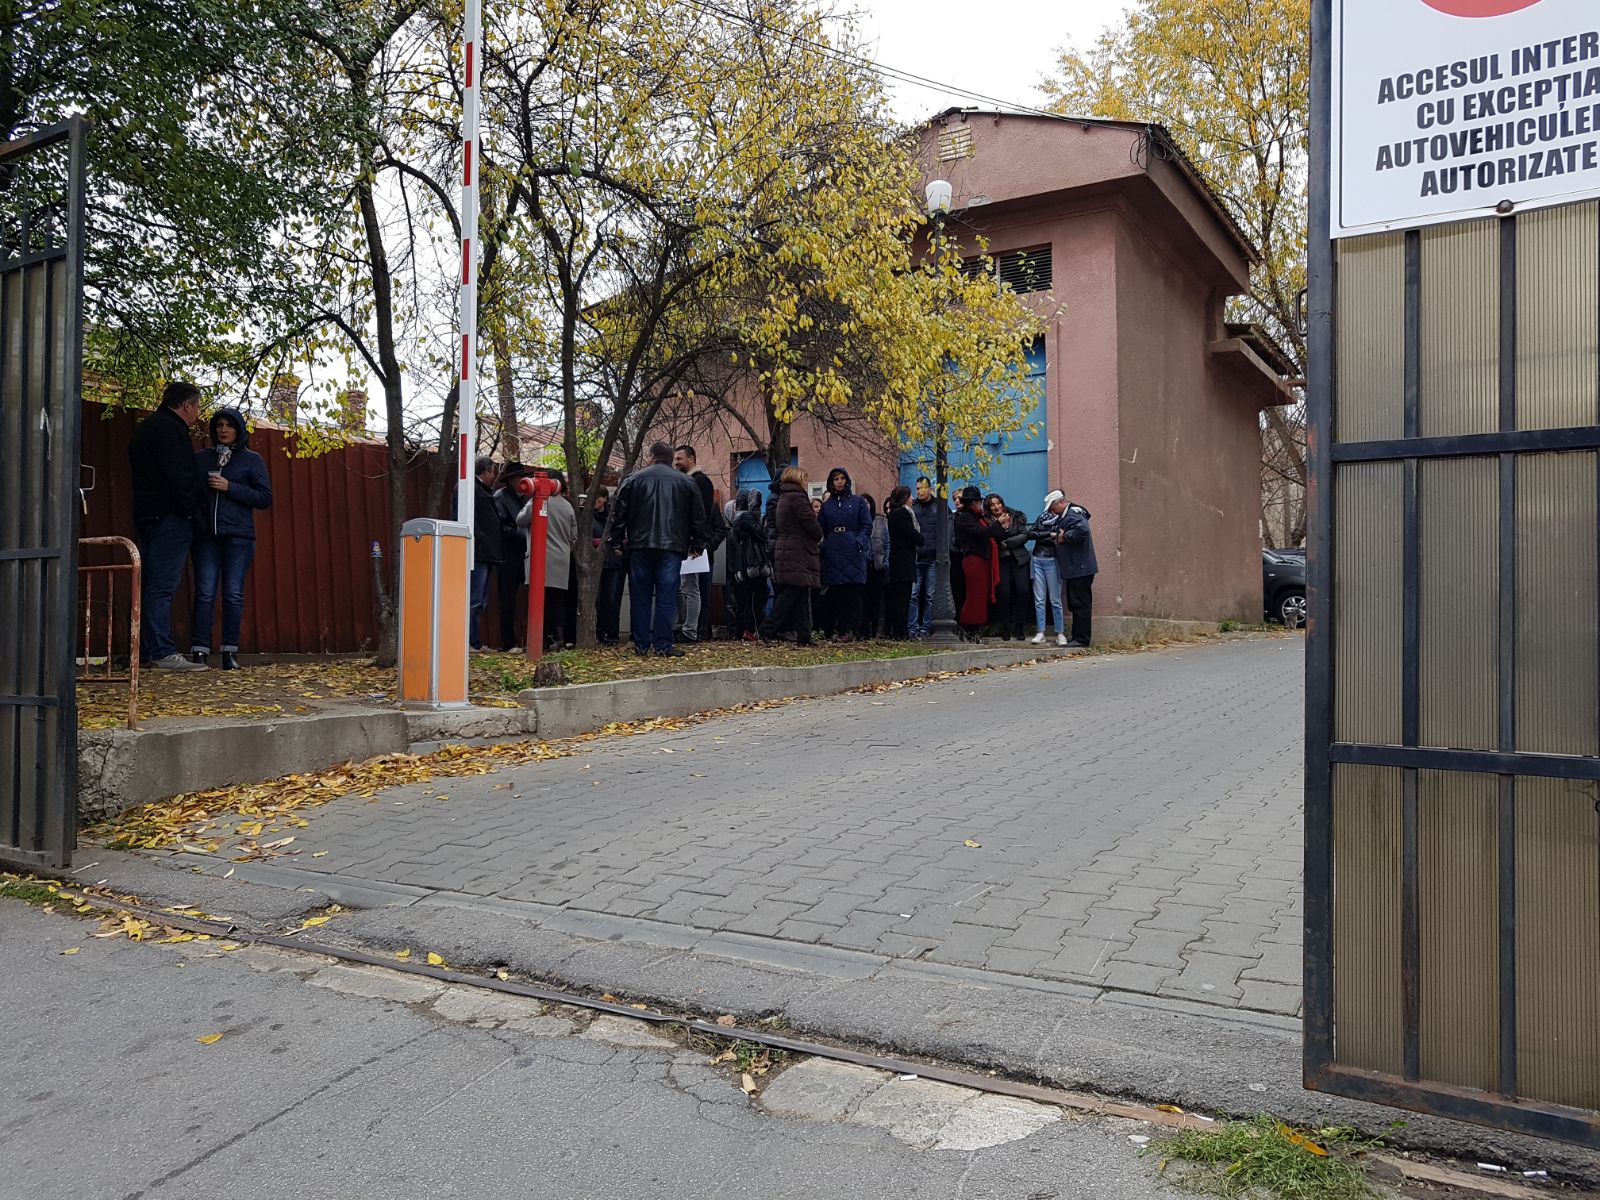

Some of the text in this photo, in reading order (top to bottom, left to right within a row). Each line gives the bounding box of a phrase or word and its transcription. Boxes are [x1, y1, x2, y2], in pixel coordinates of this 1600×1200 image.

[1377, 31, 1599, 104] ACCESUL INTER
[1417, 98, 1455, 129] CU
[1420, 141, 1598, 197] AUTORIZATE
